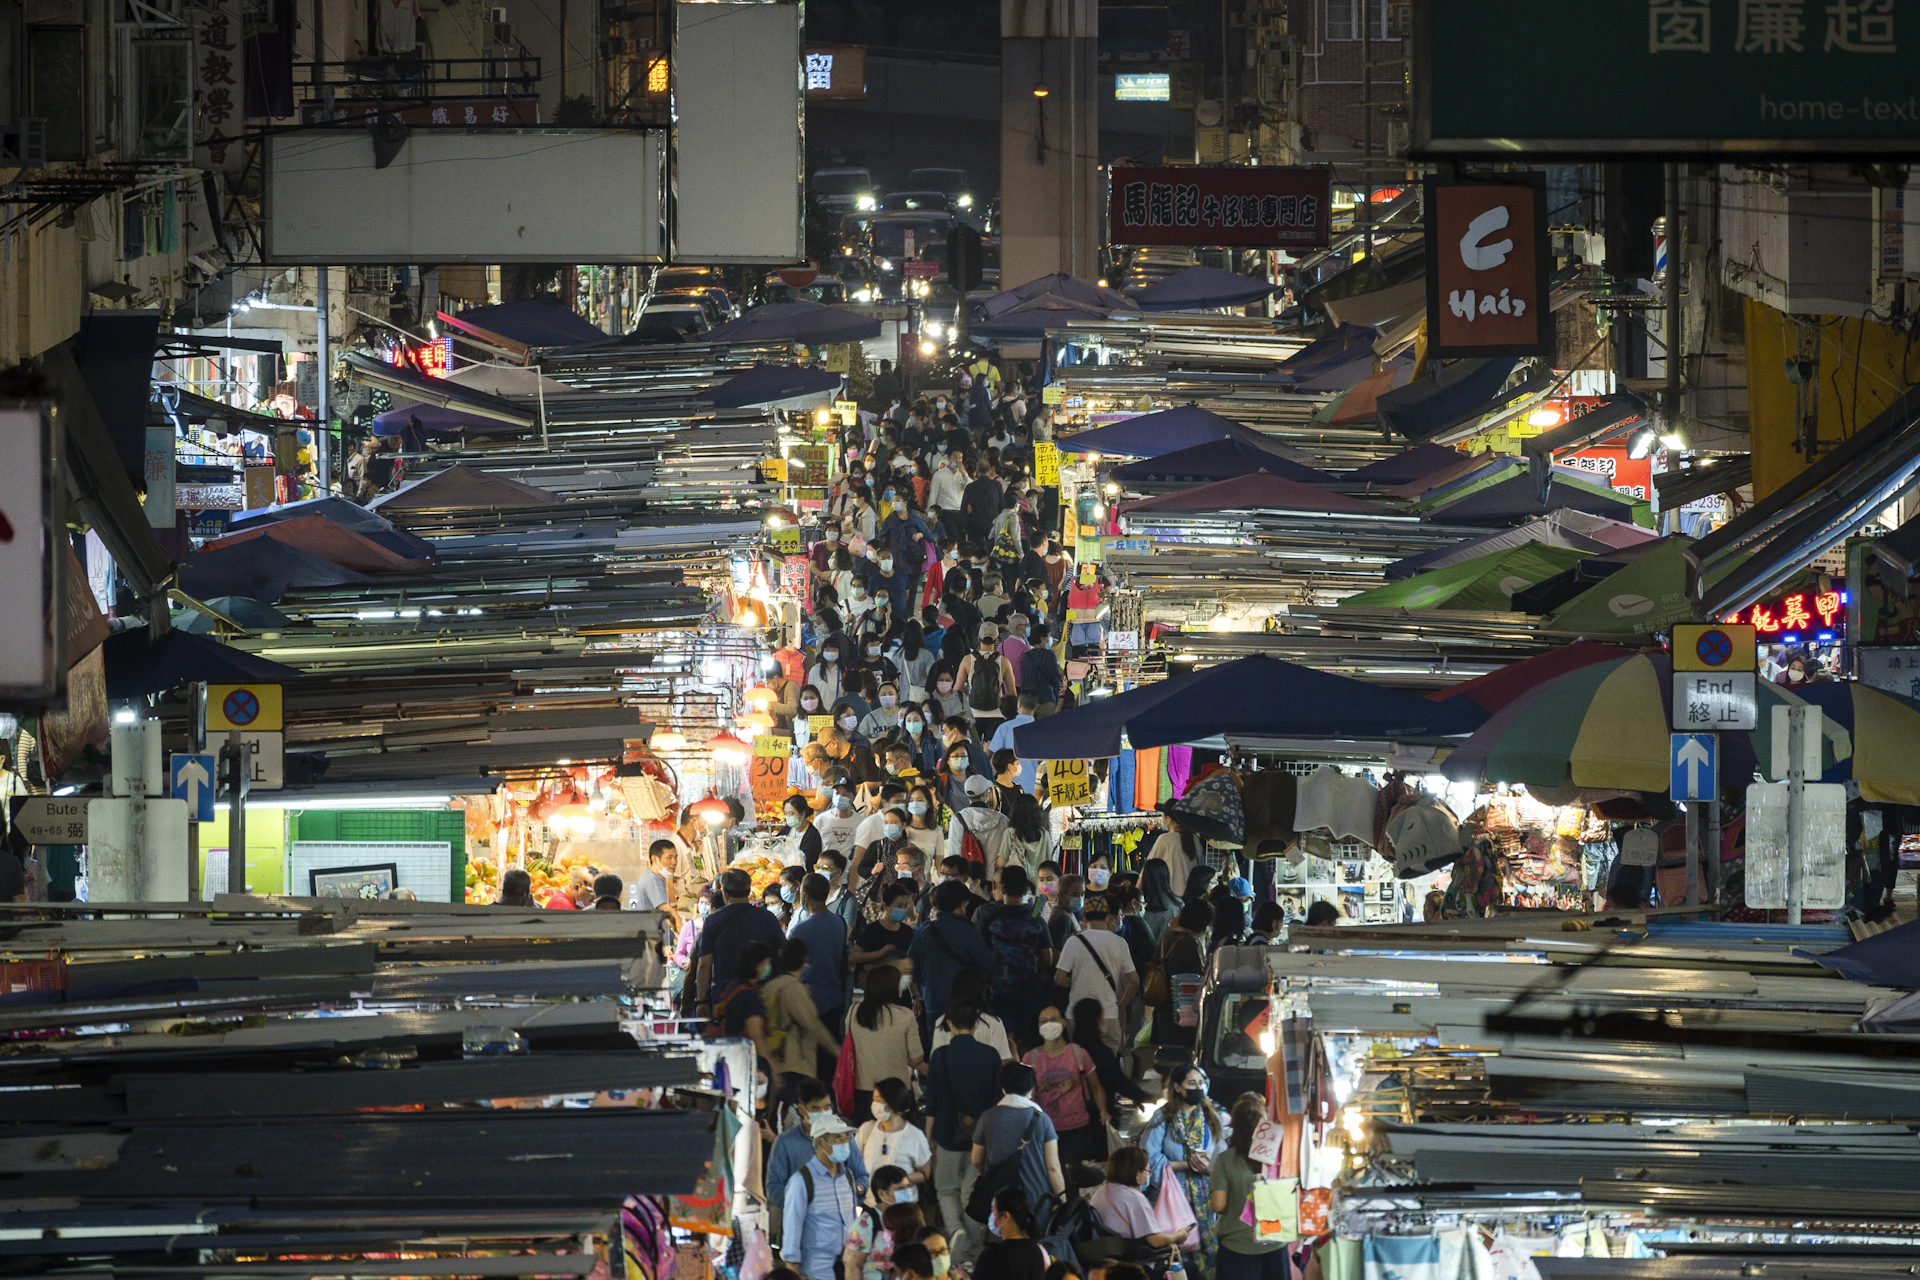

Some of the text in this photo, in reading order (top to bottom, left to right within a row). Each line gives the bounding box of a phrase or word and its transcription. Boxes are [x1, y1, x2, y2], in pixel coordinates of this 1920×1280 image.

[1123, 182, 1200, 227] 馬龍記
[1448, 288, 1527, 322] Hair
[1696, 679, 1733, 694] End
[1689, 702, 1739, 723] 終止
[755, 756, 785, 777] 30
[47, 803, 78, 816] Bute
